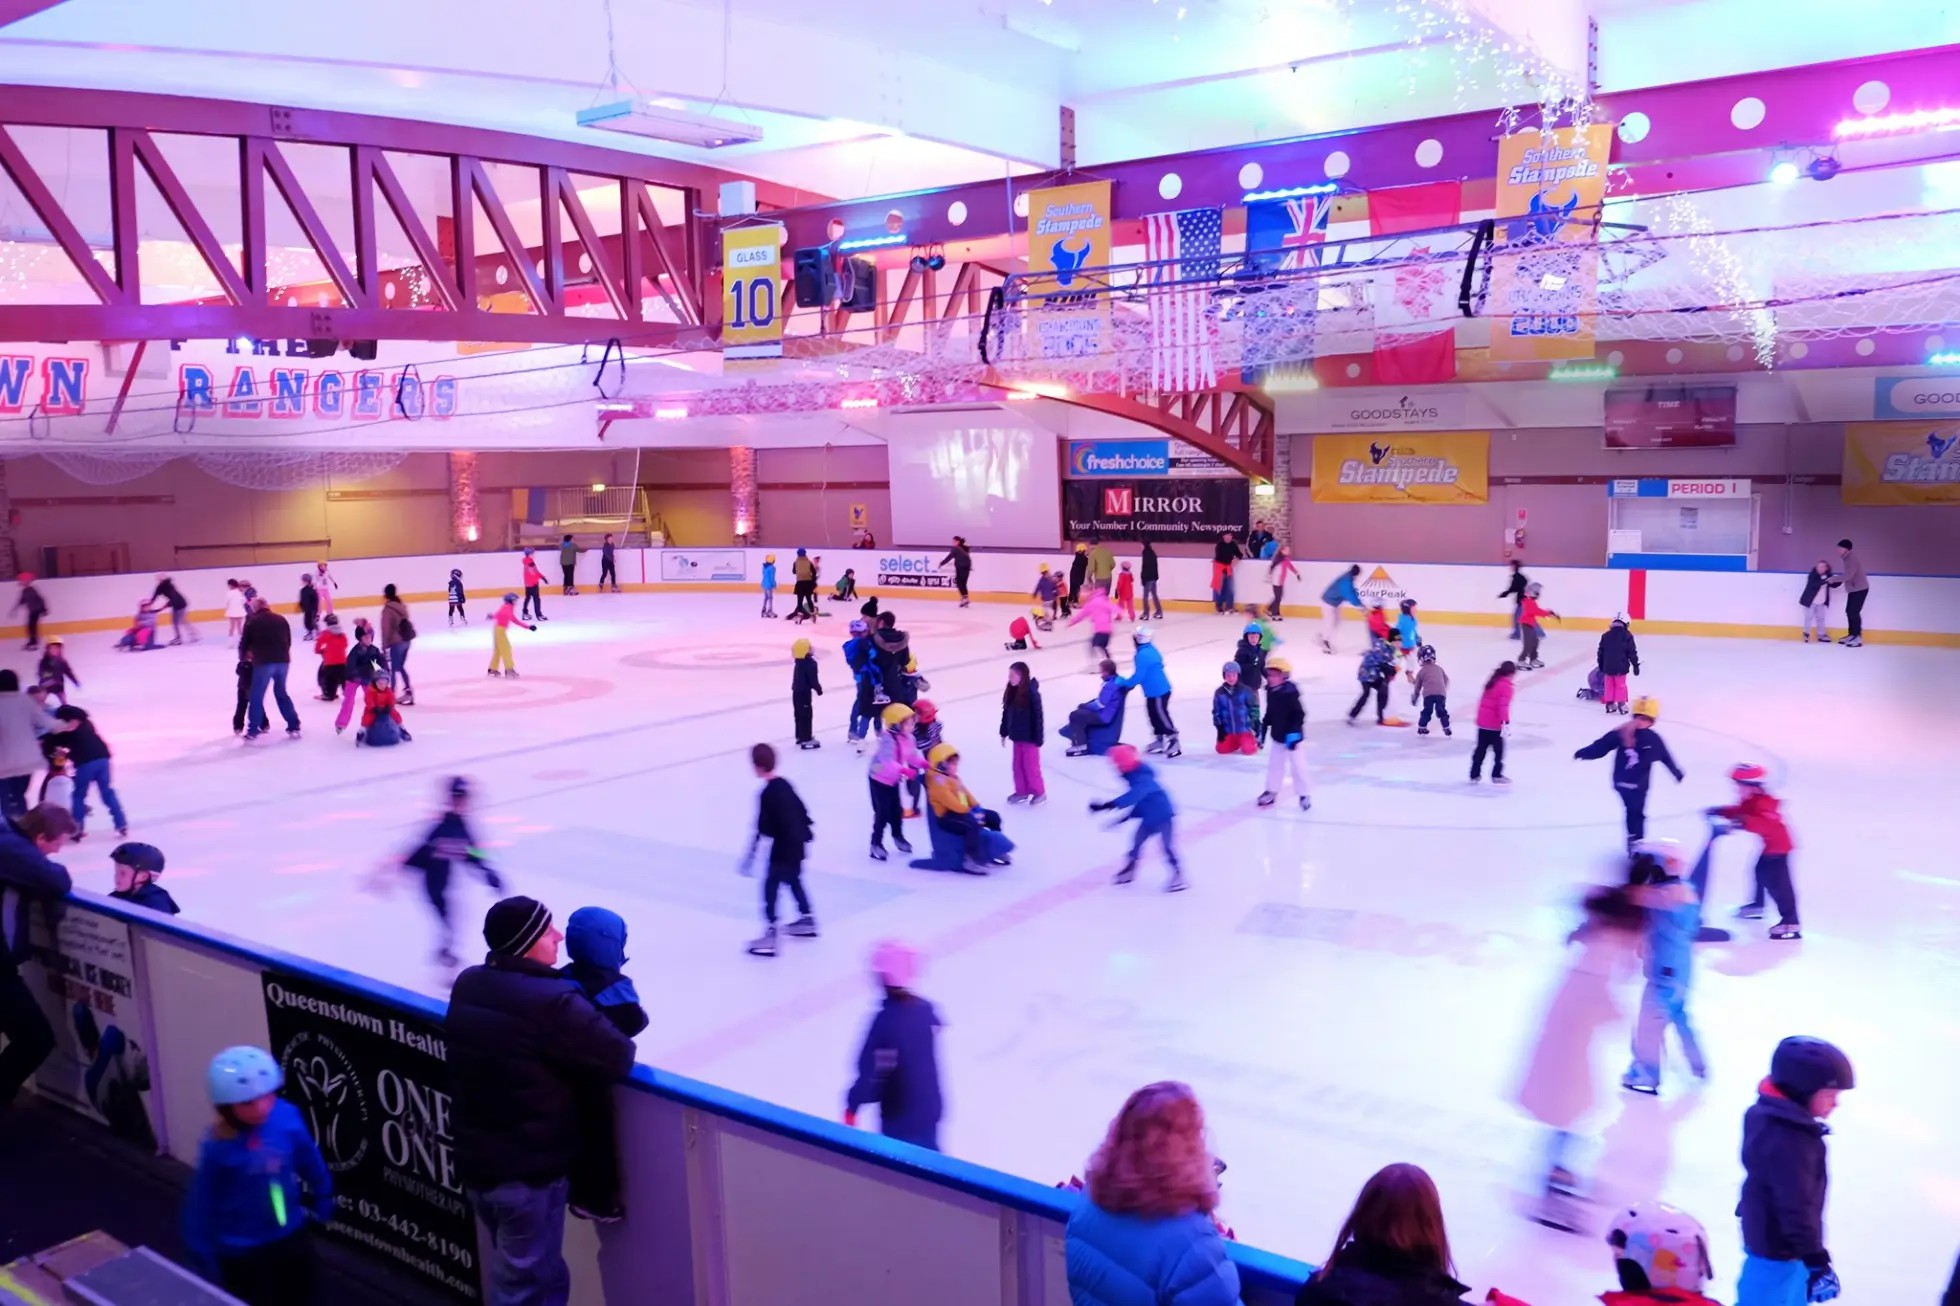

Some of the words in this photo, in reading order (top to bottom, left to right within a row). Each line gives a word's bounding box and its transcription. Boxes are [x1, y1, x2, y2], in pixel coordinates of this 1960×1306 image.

[1508, 160, 1599, 186] Stampede
[1046, 204, 1094, 217] Southern
[1036, 216, 1104, 236] Stampede
[736, 250, 768, 263] GLASS
[730, 277, 775, 329] 10
[179, 364, 459, 420] RANGERS
[1350, 407, 1439, 420] GOODSTAYS
[1086, 454, 1165, 470] freshchoice
[1339, 459, 1459, 489] Stampede
[1107, 489, 1203, 513] MIRROR
[1671, 483, 1725, 494] PERIOD
[1069, 520, 1091, 530] Your
[1092, 520, 1127, 530] Number
[1136, 520, 1190, 533] Community
[266, 982, 385, 1035] Queenstown
[377, 1068, 455, 1142] ONE
[382, 1120, 463, 1195] ONE
[358, 1197, 473, 1269] 03-442-8190
